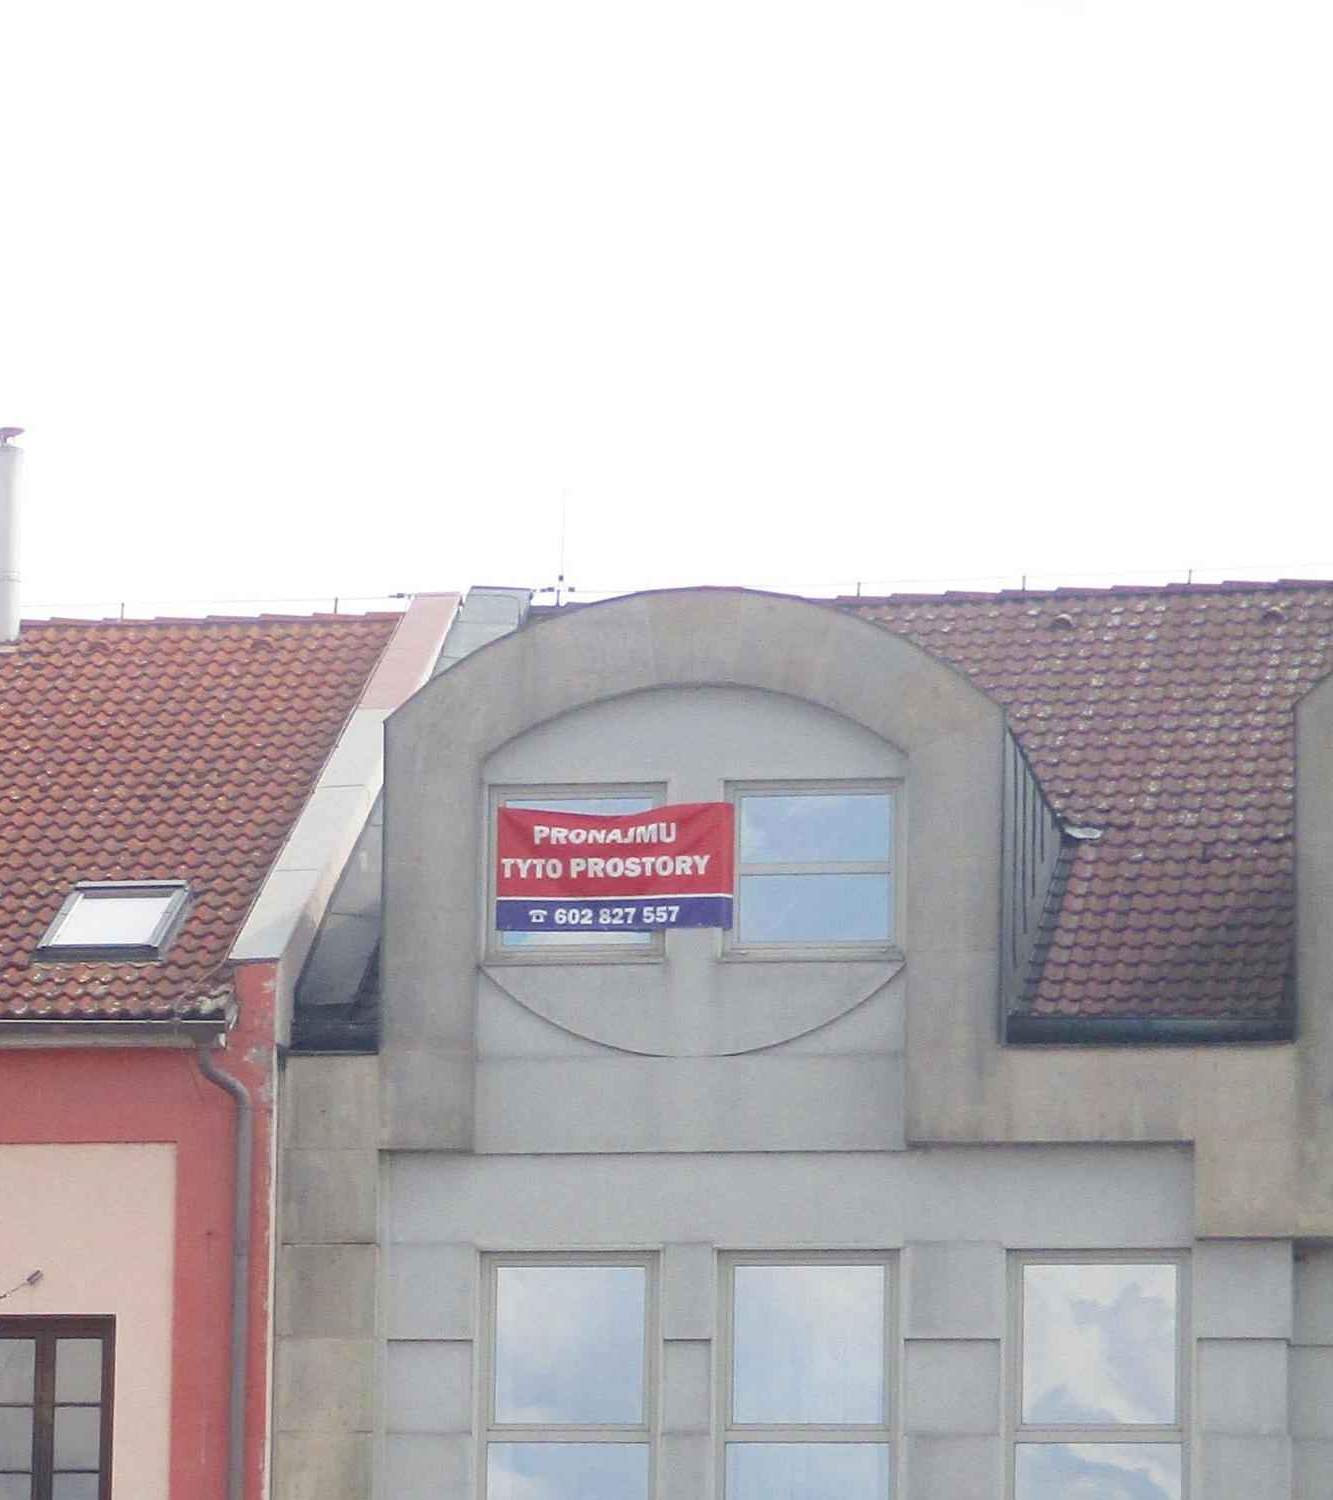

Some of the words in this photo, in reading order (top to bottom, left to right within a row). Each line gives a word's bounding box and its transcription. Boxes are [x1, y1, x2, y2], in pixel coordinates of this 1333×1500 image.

[533, 822, 677, 845] PRONAJMU
[501, 858, 563, 879] TYTO
[570, 854, 711, 879] PROSTORY
[554, 908, 593, 925] 602
[599, 907, 636, 924] 827
[643, 905, 680, 923] 557
